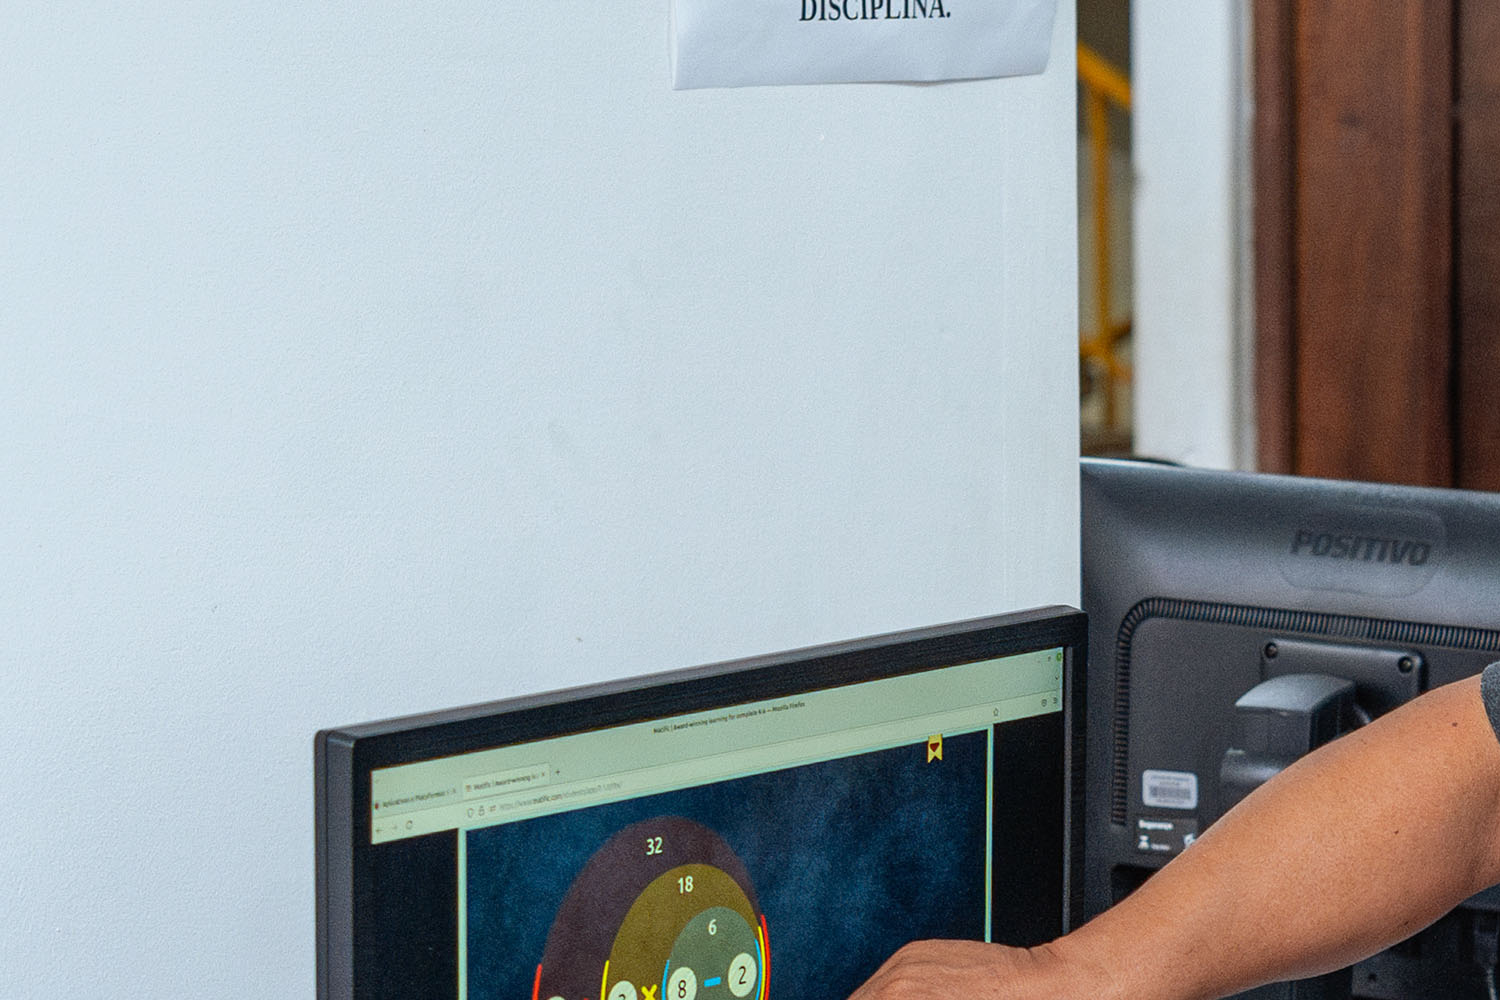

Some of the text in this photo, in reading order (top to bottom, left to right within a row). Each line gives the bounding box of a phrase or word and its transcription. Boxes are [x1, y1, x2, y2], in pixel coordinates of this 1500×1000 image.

[800, 0, 951, 21] DISCIPLINA.
[1290, 529, 1430, 565] POSITIVO
[646, 837, 663, 856] 32
[678, 876, 694, 894] 18
[708, 919, 717, 935] 6
[678, 979, 687, 1000] 8
[738, 965, 747, 985] 2
